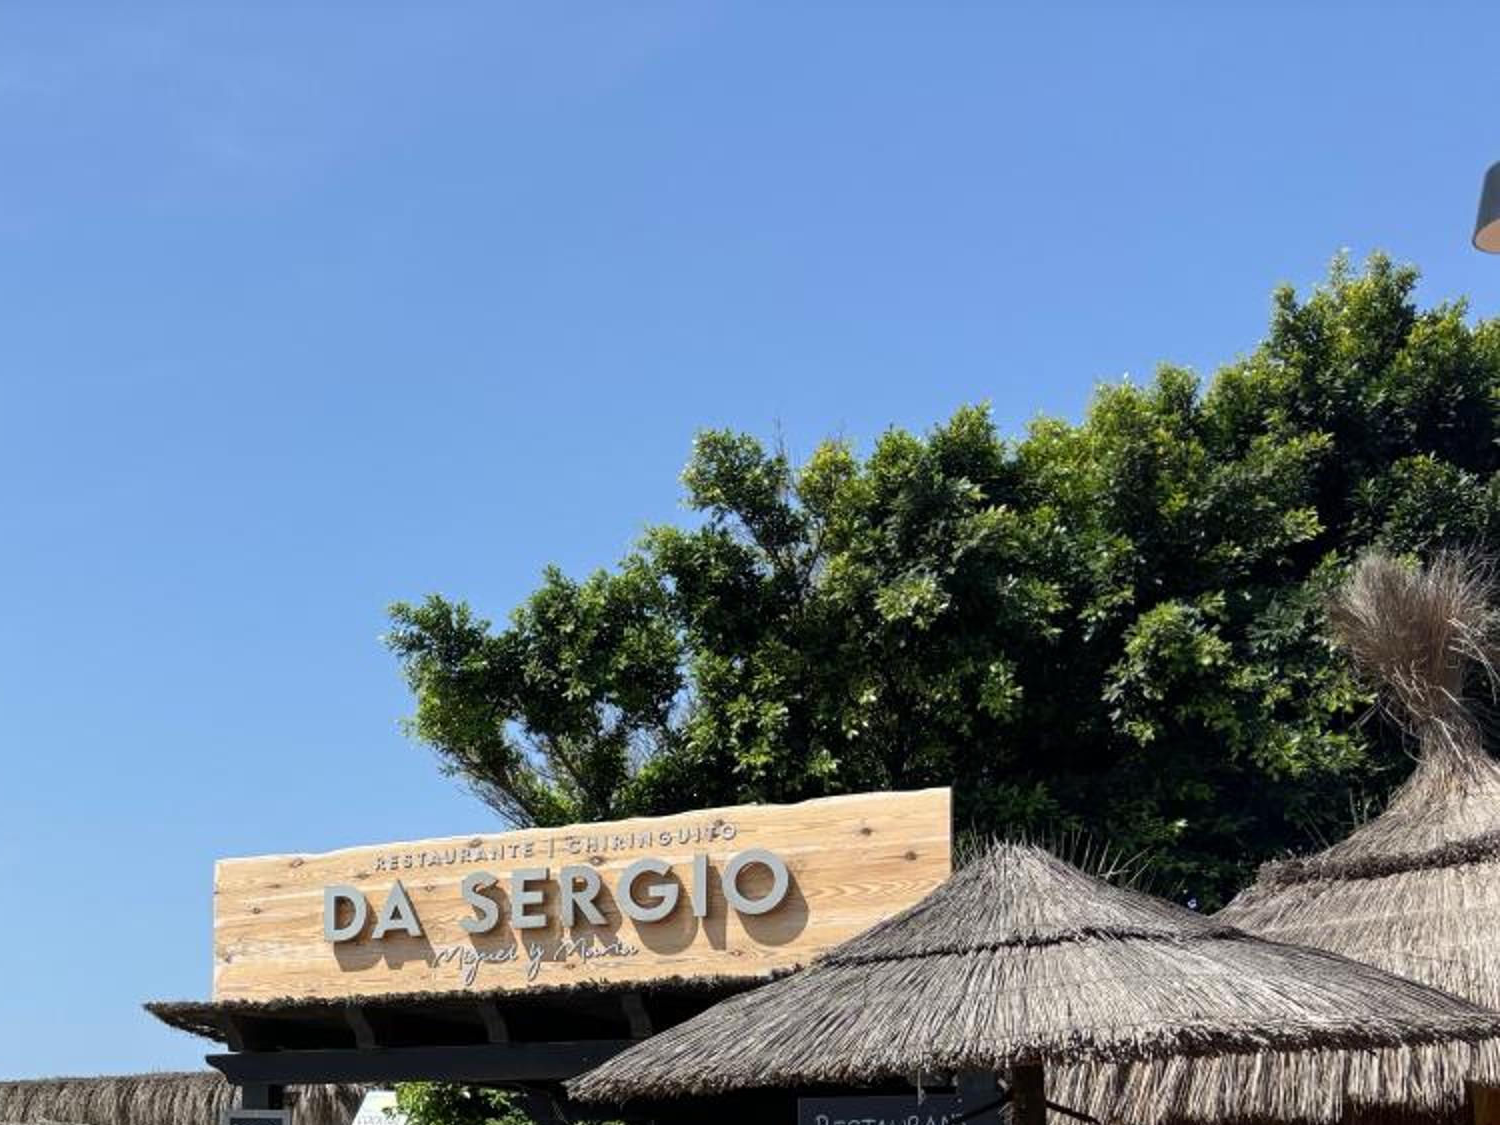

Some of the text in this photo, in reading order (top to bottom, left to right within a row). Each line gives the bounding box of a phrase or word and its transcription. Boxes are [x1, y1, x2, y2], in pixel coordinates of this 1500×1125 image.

[375, 823, 737, 872] RESTAURANTE CHIRINGUITO
[323, 847, 790, 943] DA SERGIO
[433, 945, 518, 986] Miguel
[527, 943, 544, 982] y
